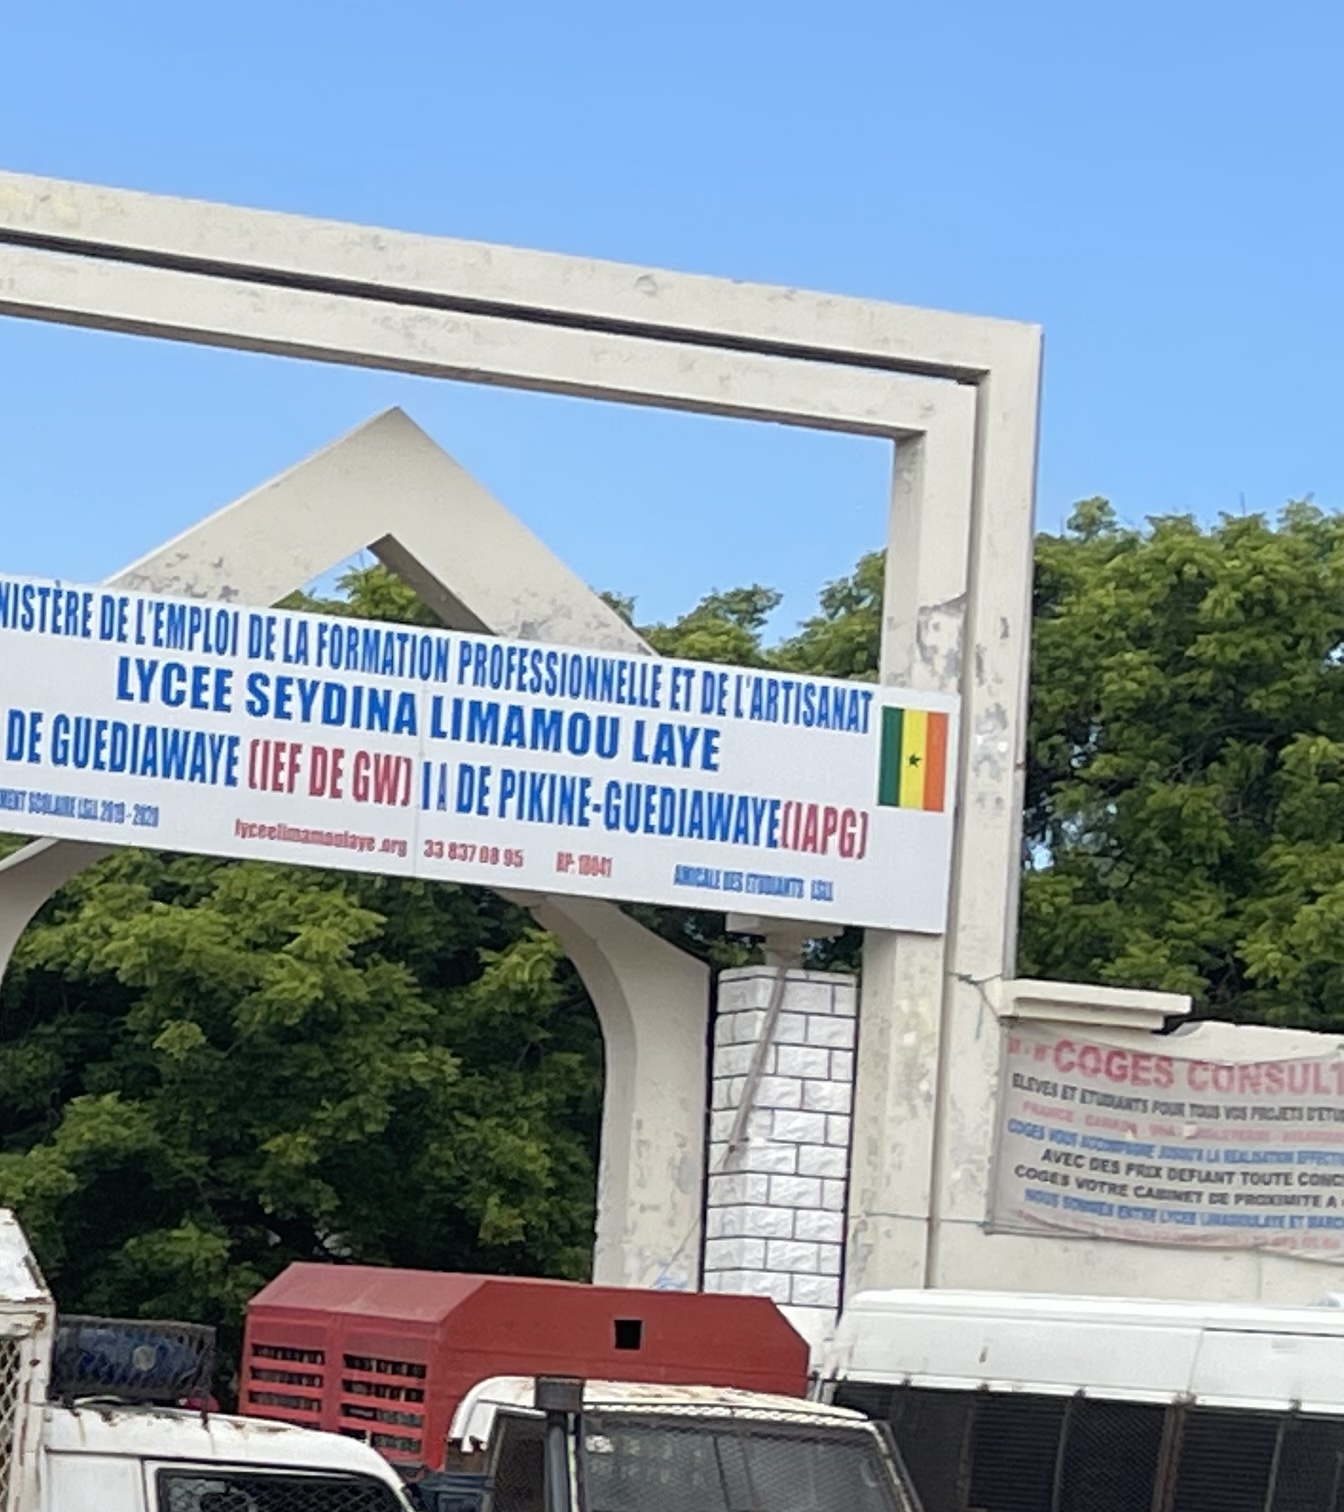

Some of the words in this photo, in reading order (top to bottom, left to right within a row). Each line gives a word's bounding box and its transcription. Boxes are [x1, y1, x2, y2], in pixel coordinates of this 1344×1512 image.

[99, 594, 129, 643] DE
[136, 599, 239, 657] L'EMPLOI
[248, 613, 277, 661] DE
[283, 618, 310, 666] LA
[316, 622, 450, 683] FORMATION
[457, 640, 662, 709] PROFESSIONNELLE
[669, 666, 695, 713] ET
[701, 671, 729, 717] DE
[734, 675, 874, 734] L'ARTISANAT
[116, 656, 234, 713] LYCEE
[245, 671, 418, 736] SEYDINA
[430, 695, 620, 760] LIMAMOU
[632, 720, 721, 772] LAYE
[5, 708, 44, 764] DE
[50, 713, 240, 787] GUEDIAWAYE
[248, 738, 304, 795] (IEF
[308, 745, 344, 800] DE
[352, 751, 414, 808] GW)
[456, 762, 492, 816] DE
[423, 838, 444, 859] 33
[448, 841, 477, 863] 837
[503, 848, 524, 868] 95
[1053, 1039, 1175, 1089] COGES
[1014, 1163, 1070, 1187] COGES
[1074, 1175, 1129, 1198] VOTRE
[1041, 1148, 1087, 1169] AVEC
[1089, 1156, 1121, 1175] DES
[1125, 1162, 1163, 1180] PRIX
[1166, 1167, 1236, 1185] DEFIANT
[1240, 1171, 1293, 1187] TOUTE
